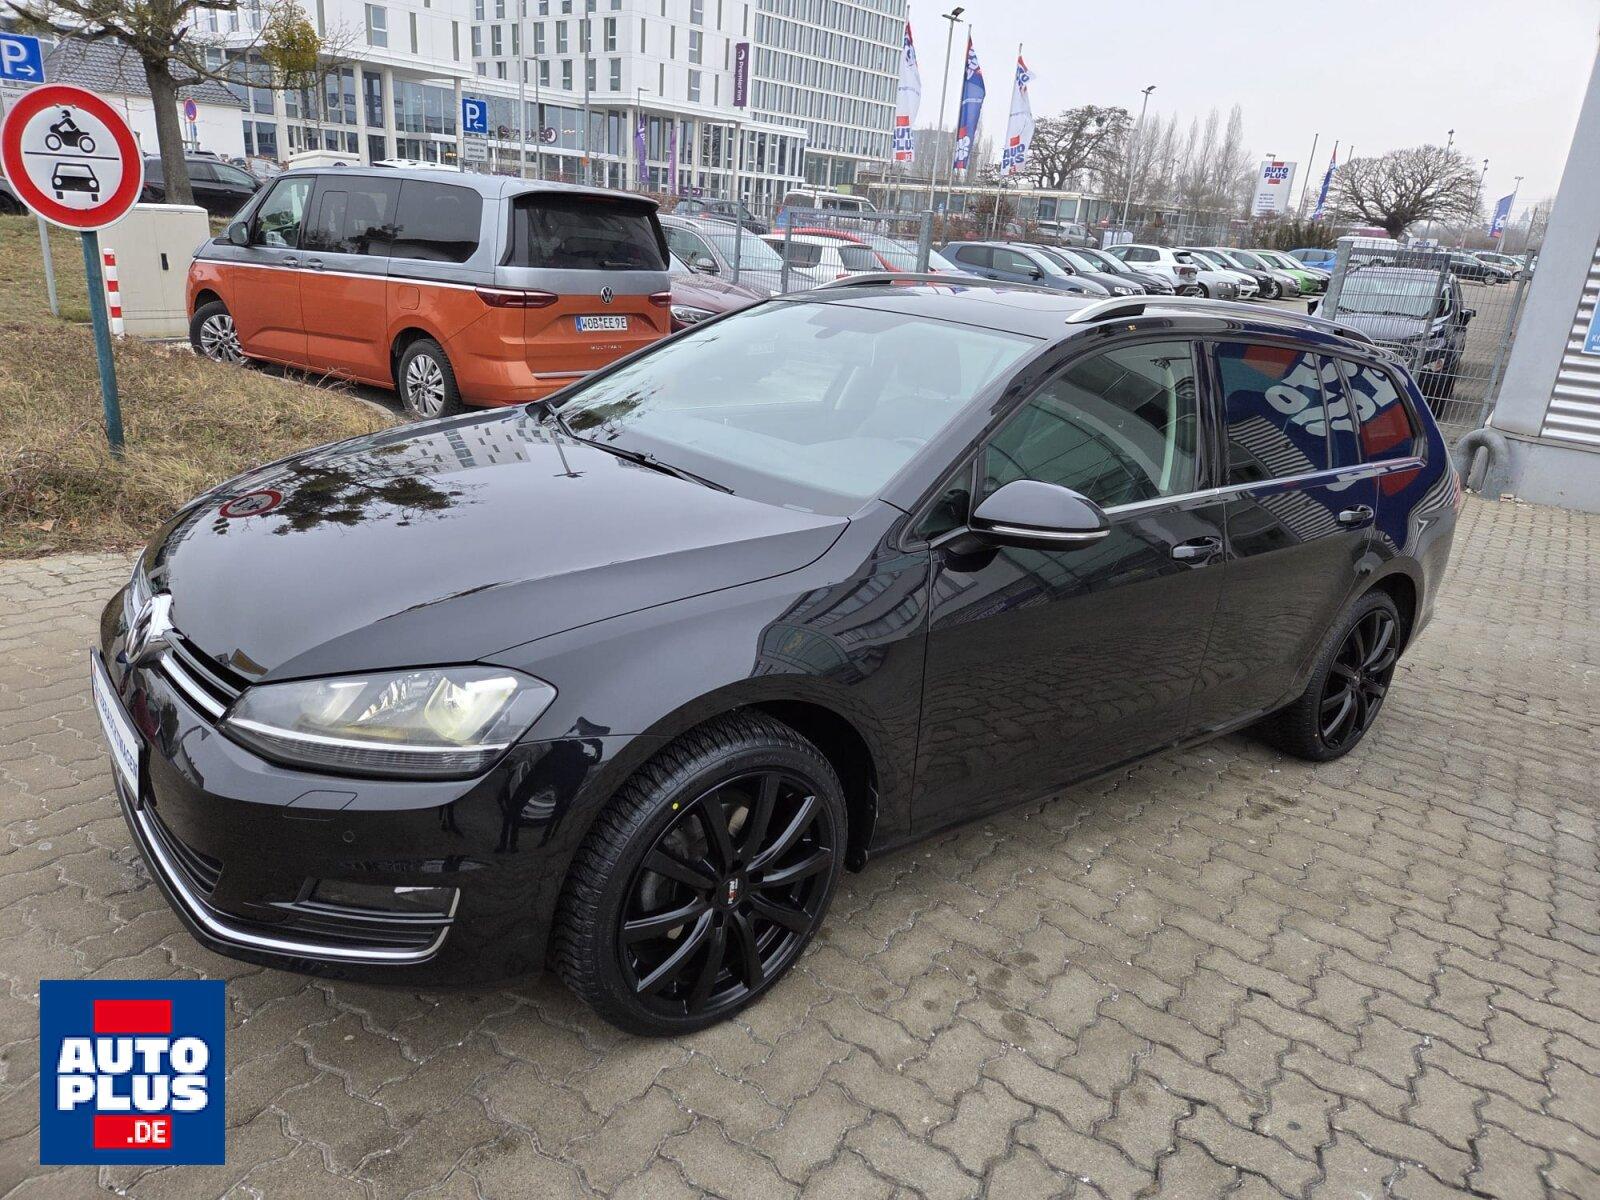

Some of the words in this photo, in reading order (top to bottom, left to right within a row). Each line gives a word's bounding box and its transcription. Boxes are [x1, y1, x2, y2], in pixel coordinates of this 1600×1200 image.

[1, 40, 27, 75] P
[465, 102, 480, 128] P
[581, 317, 600, 329] WOB
